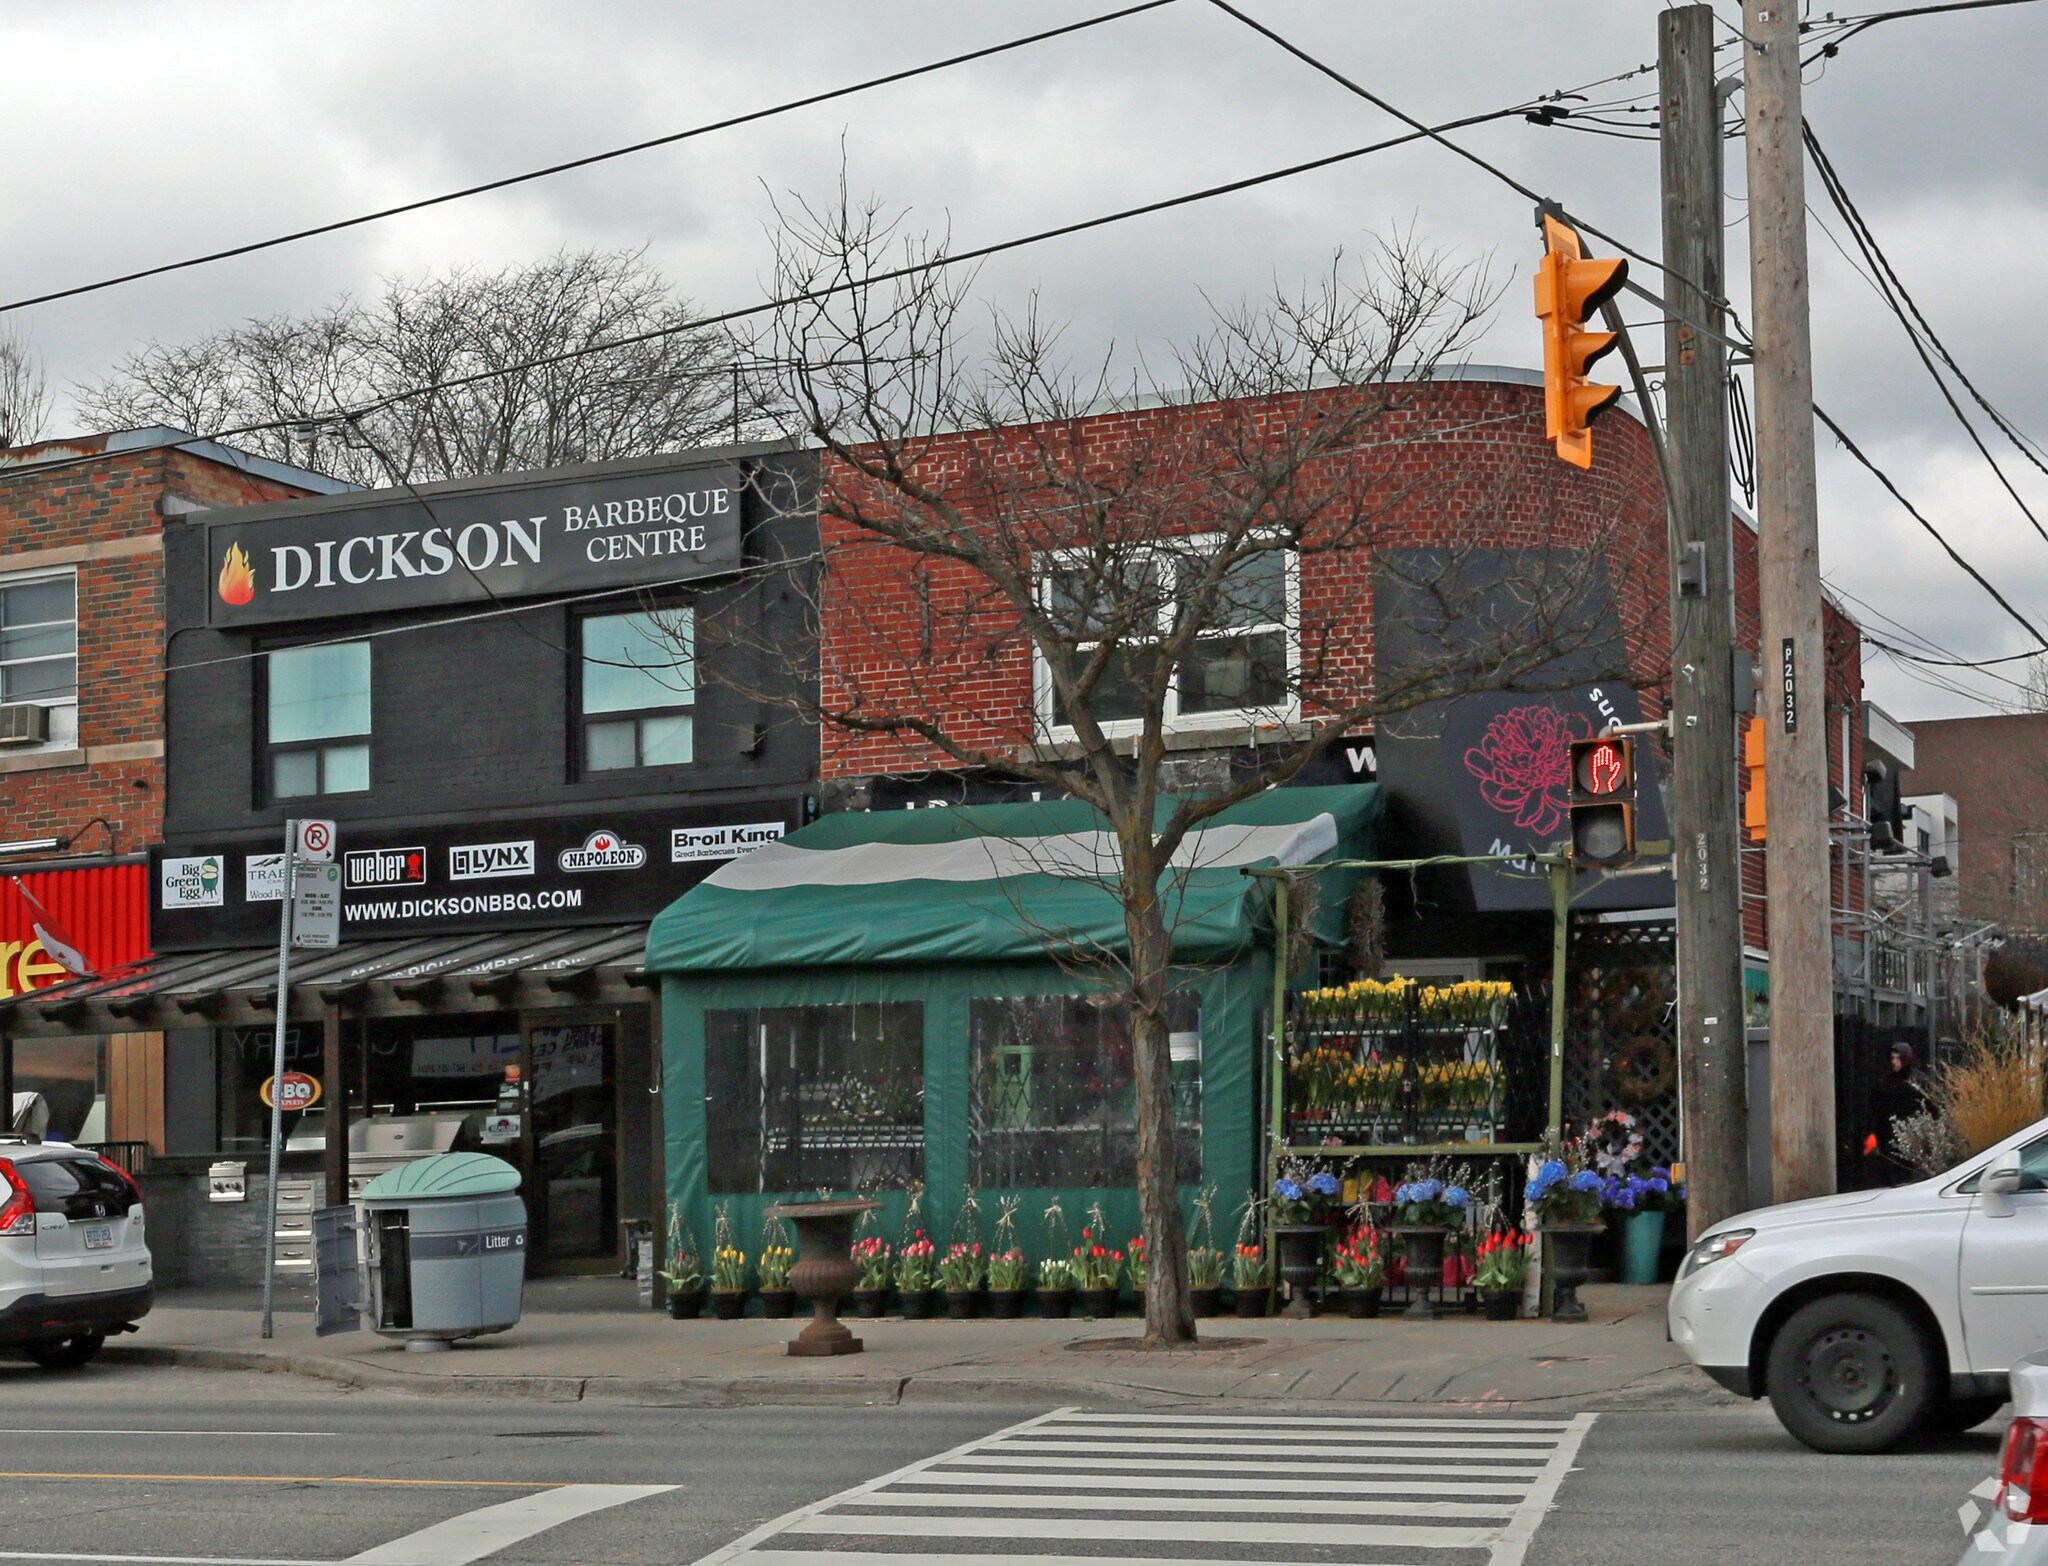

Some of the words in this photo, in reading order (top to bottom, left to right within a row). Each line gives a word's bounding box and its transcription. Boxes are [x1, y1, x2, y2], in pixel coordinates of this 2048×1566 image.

[563, 488, 730, 532] BARBEQUE
[270, 516, 548, 593] DICKSON
[586, 525, 707, 564] CENTRE
[1785, 648, 1794, 724] P2032
[674, 828, 725, 847] Broil
[732, 826, 779, 843] King
[473, 845, 528, 872] LYNX
[568, 849, 636, 868] NAPOLEON
[675, 850, 695, 858] Great
[697, 848, 735, 857] Barbecues
[182, 864, 200, 877] Big
[248, 869, 285, 880] TRAE
[350, 850, 405, 883] weber
[166, 876, 200, 888] Green
[179, 886, 200, 900] Egg
[249, 889, 273, 899] Wood
[344, 889, 582, 921] WWW.DICKSONBBQ.COM
[0, 939, 68, 1000] re
[485, 1235, 510, 1249] Litter
